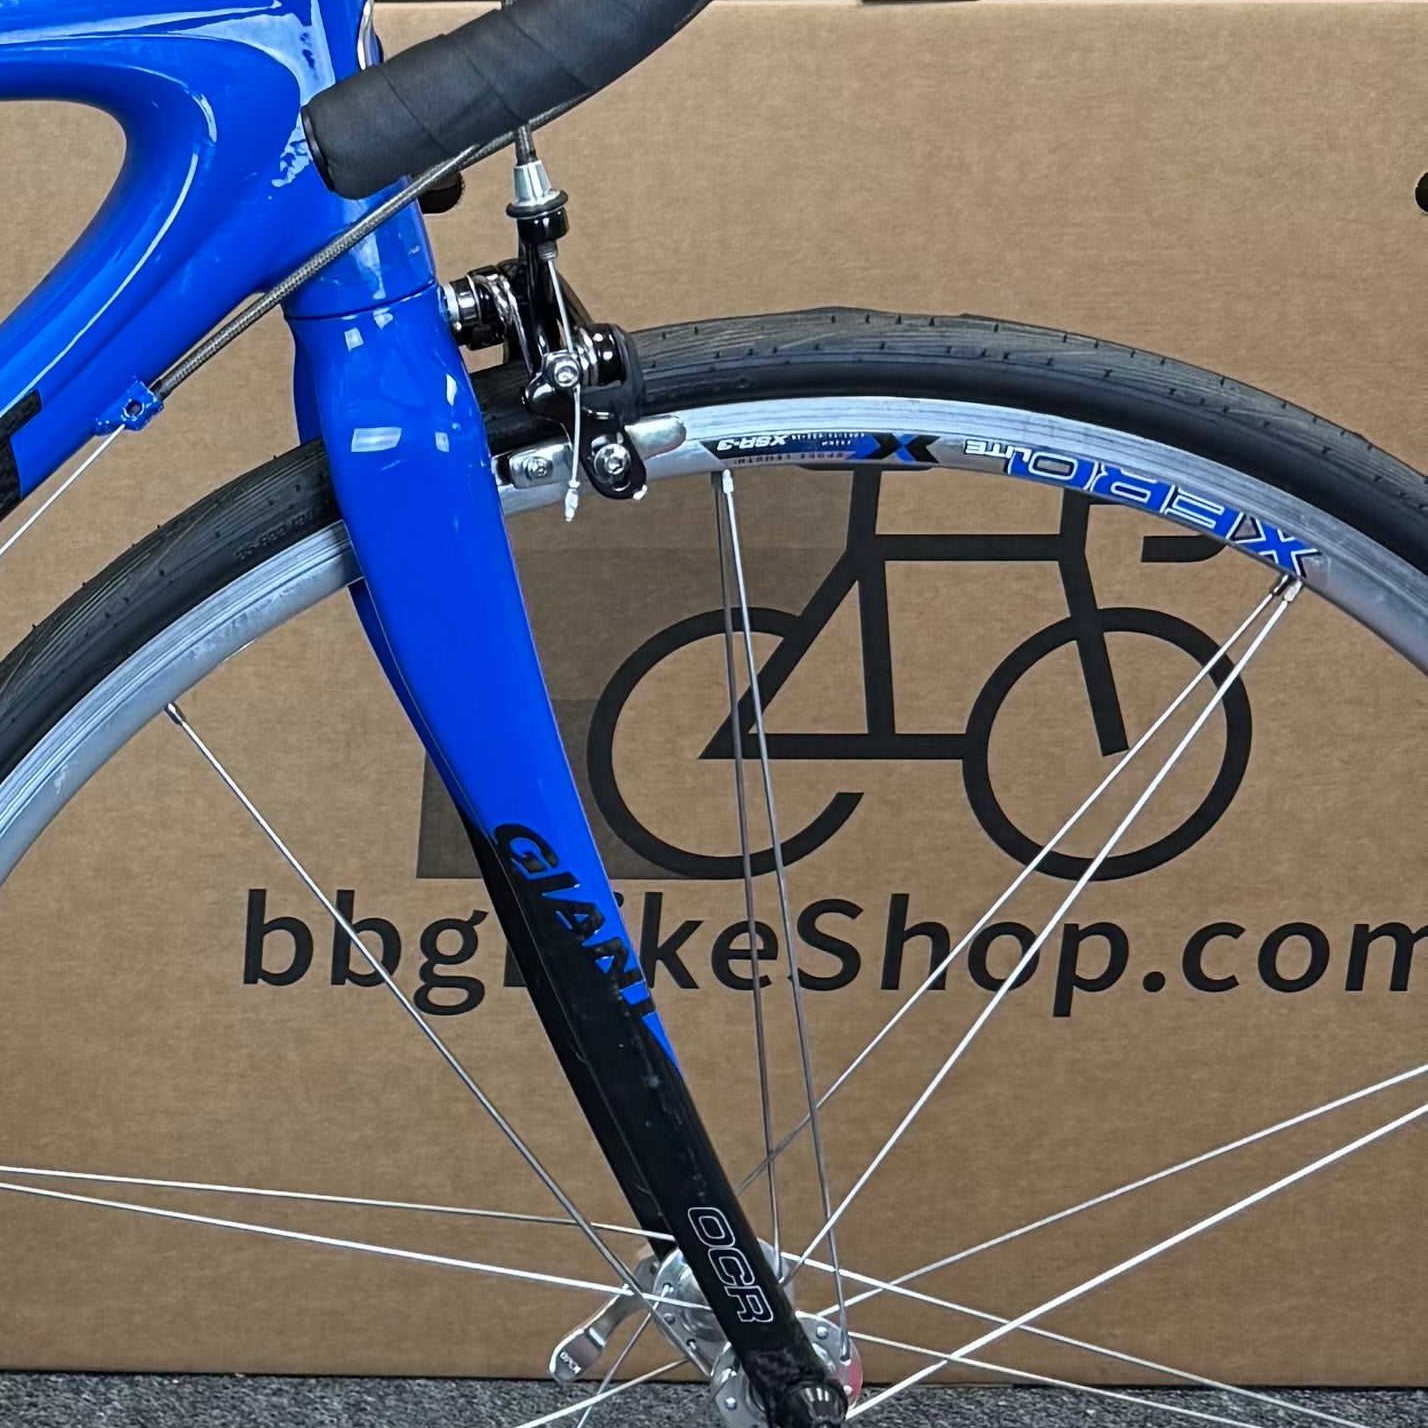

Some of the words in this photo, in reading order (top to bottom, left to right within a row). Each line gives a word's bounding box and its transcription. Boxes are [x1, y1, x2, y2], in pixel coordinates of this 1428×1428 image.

[716, 433, 789, 452] XSR-3
[963, 438, 1032, 464] LITE
[1007, 454, 1323, 579] XERO
[241, 888, 1428, 1018] bbgkeShop.com
[685, 1204, 775, 1324] OCR
